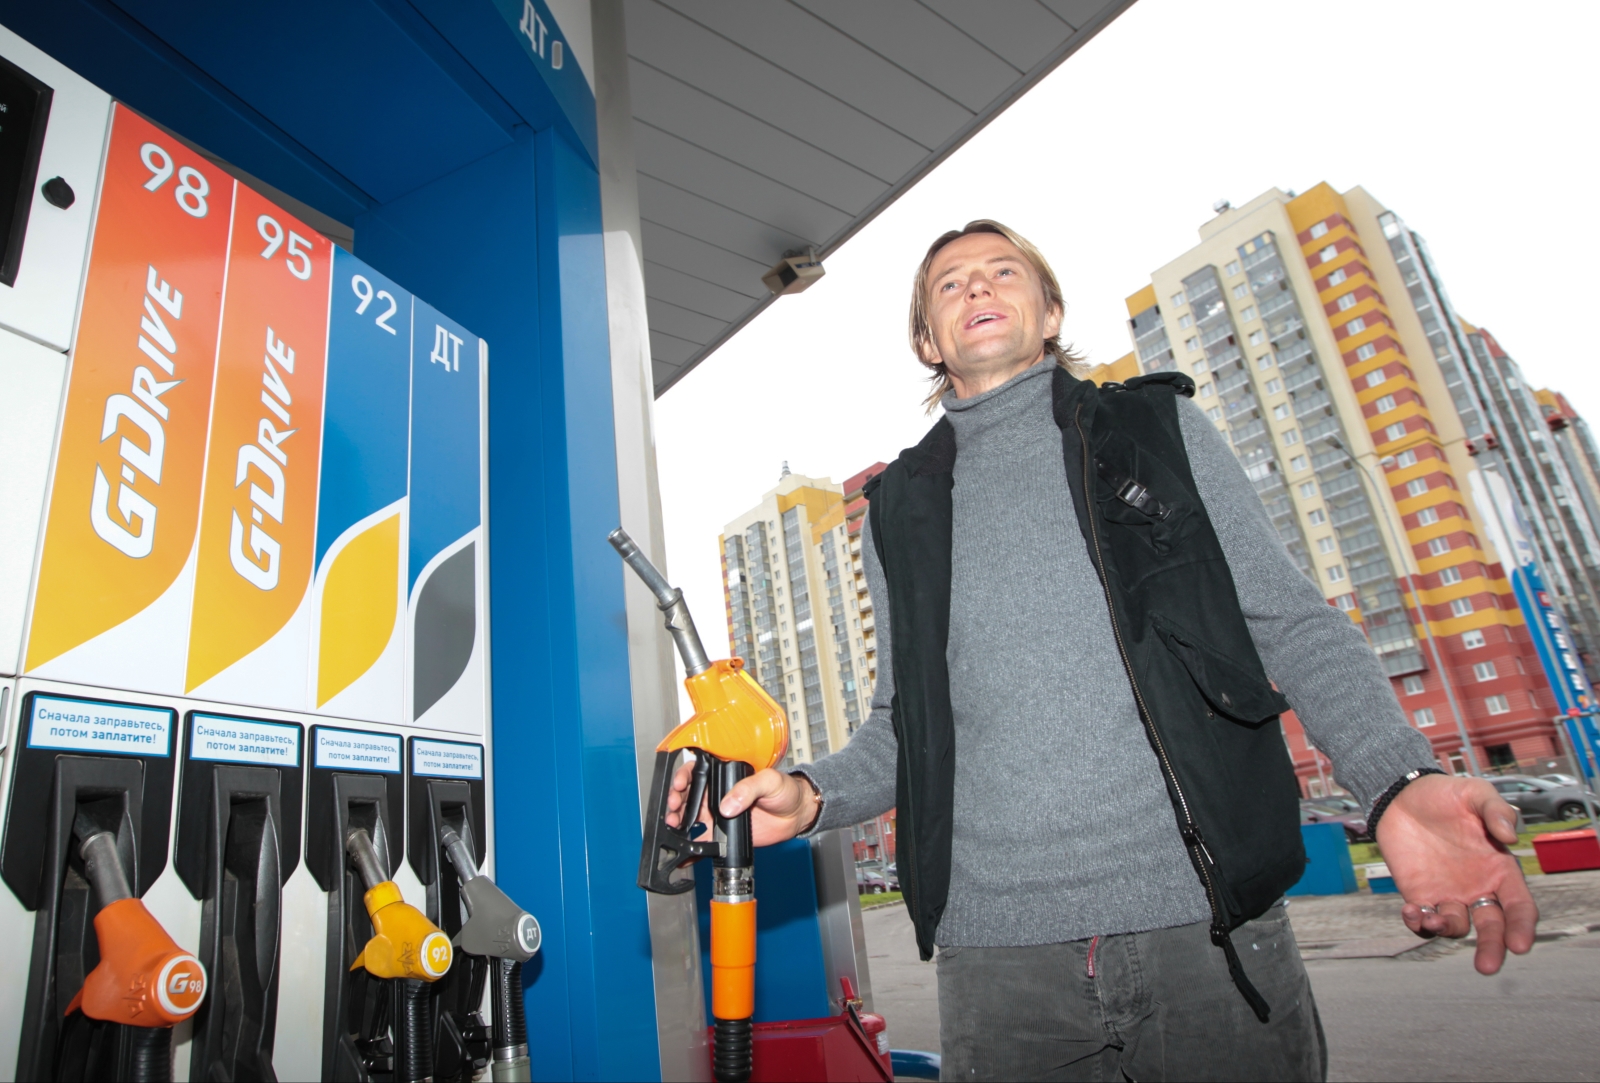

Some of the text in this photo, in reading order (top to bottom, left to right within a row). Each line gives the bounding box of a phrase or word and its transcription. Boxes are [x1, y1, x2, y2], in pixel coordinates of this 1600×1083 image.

[519, 0, 548, 60] ДТ
[139, 142, 210, 219] 98
[256, 213, 313, 281] 95
[351, 273, 398, 336] 92
[430, 323, 464, 373] ДТ
[38, 708, 165, 732] Сначала заправьтесь,
[50, 727, 156, 744] потом заплатите!
[197, 725, 295, 746] Сначала заправьтесь,
[207, 741, 288, 756] потом заплатите!
[320, 737, 397, 753] Сначала заправьтесь,
[416, 747, 442, 758] Сначала
[329, 752, 390, 763] потом заплатите!
[526, 927, 537, 941] ДТ
[432, 946, 448, 962] 92
[189, 980, 202, 993] 98
